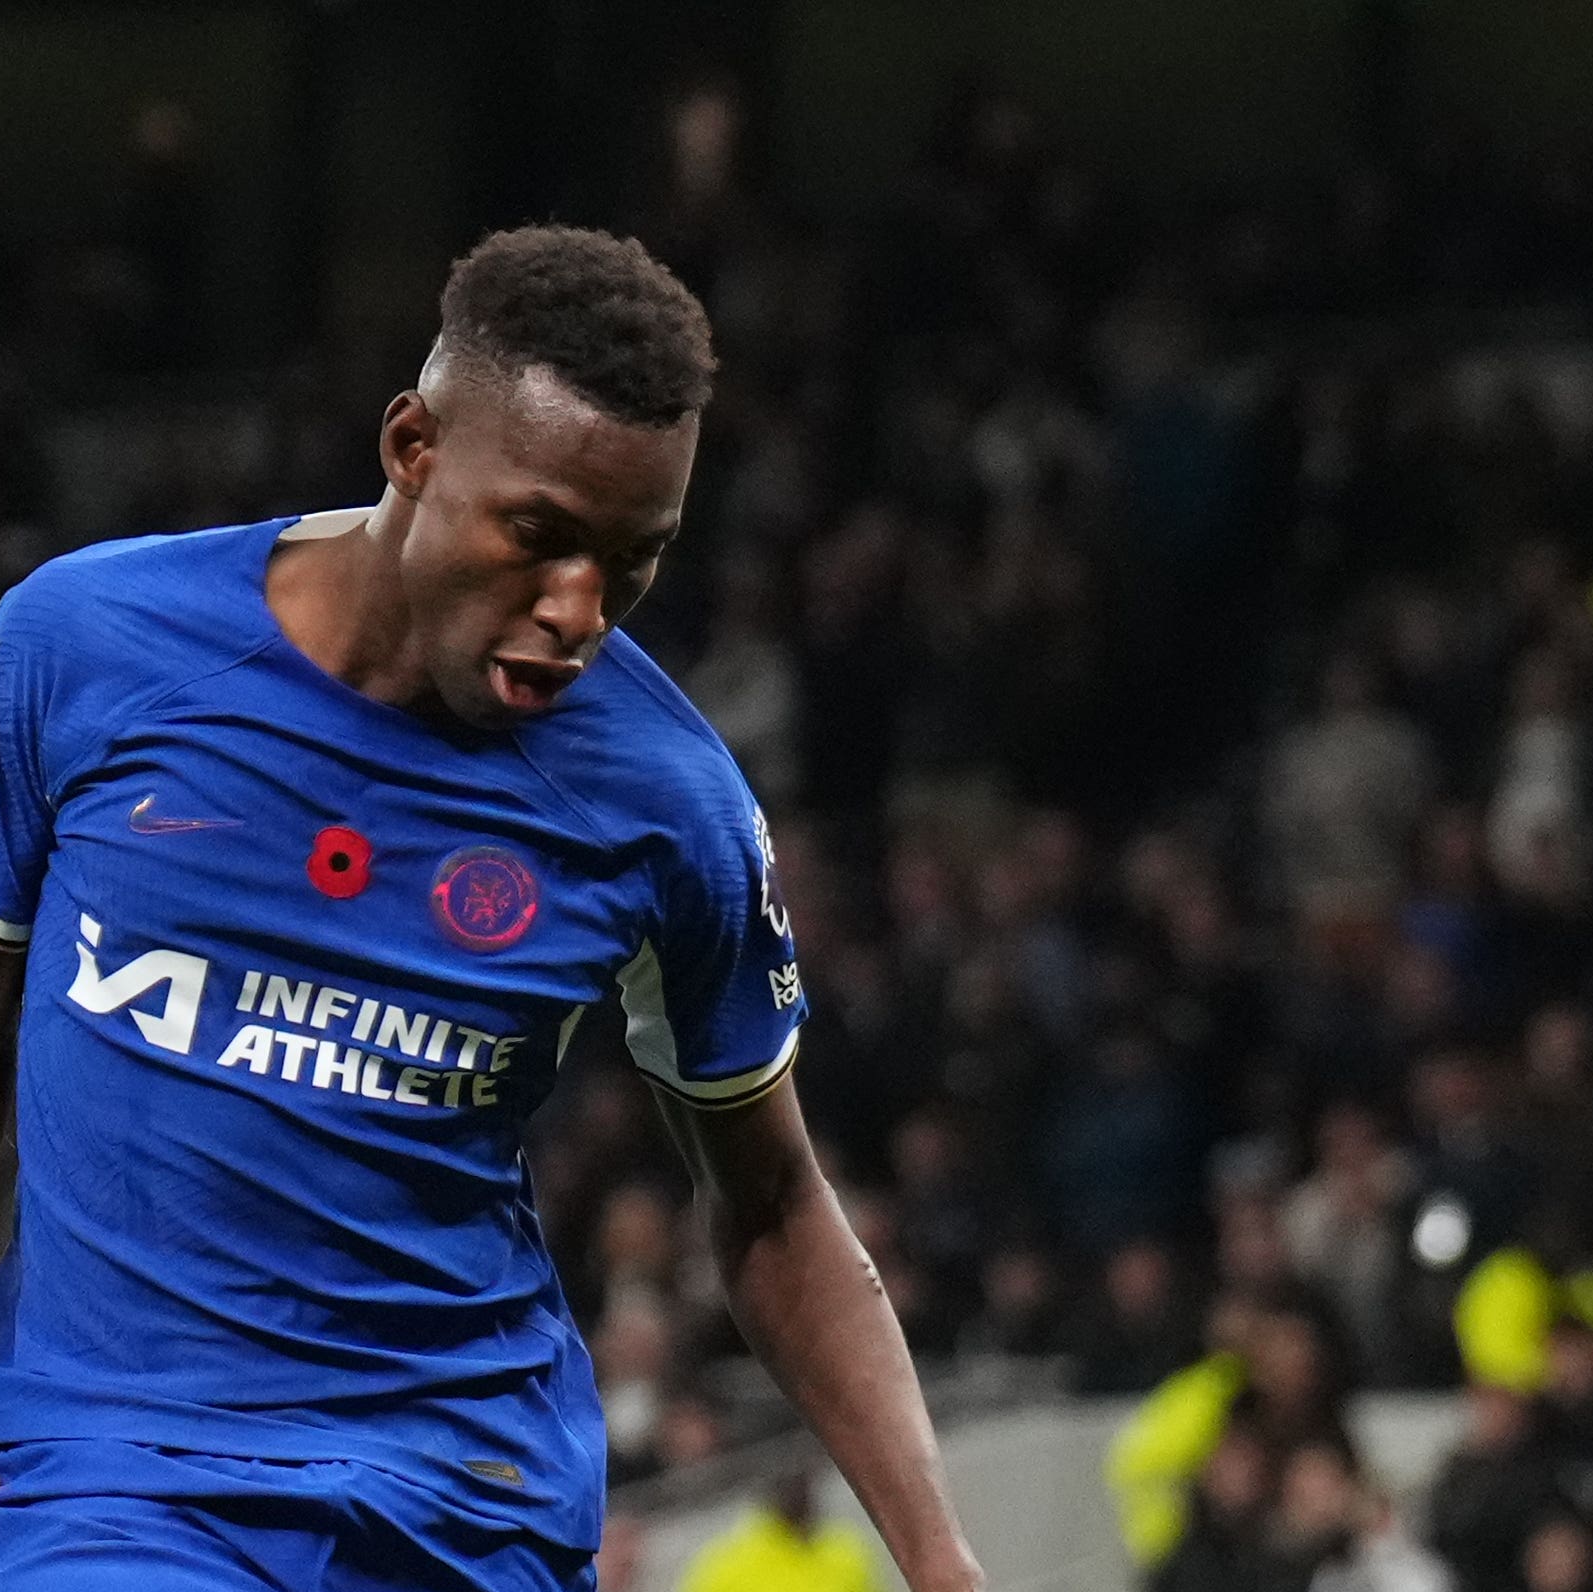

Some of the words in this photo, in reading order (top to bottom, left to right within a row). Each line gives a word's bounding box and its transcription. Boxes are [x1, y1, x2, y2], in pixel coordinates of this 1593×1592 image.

[768, 962, 797, 991] No
[773, 979, 799, 1010] for
[235, 970, 527, 1073] INFINITE
[216, 1024, 500, 1108] ATHLETE
